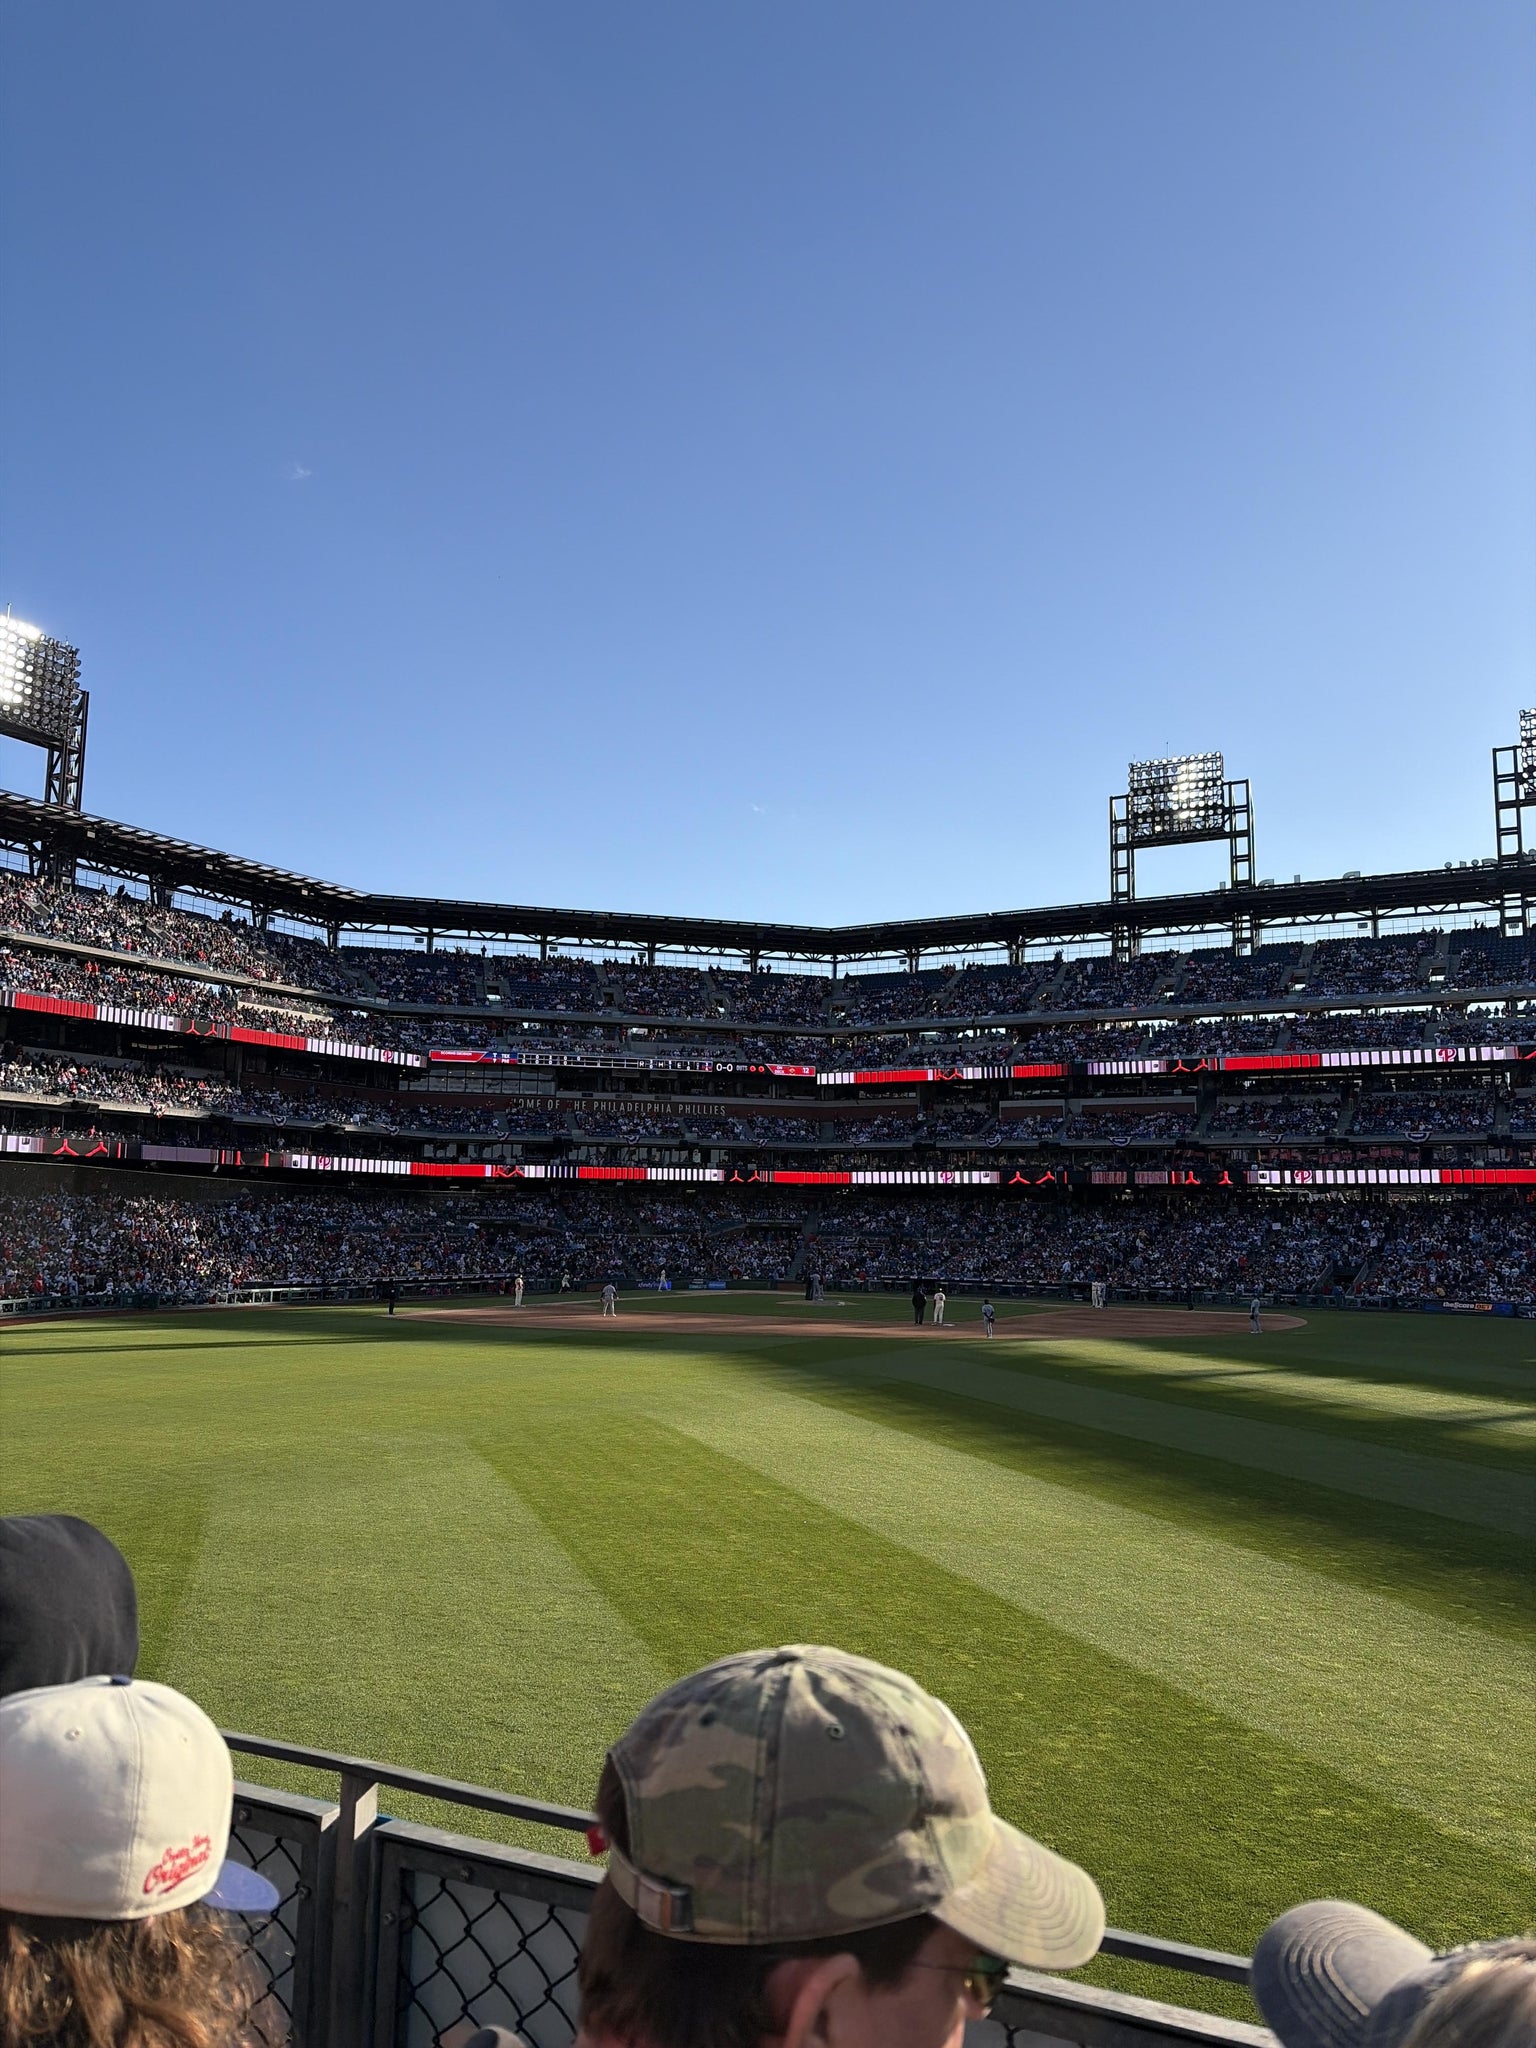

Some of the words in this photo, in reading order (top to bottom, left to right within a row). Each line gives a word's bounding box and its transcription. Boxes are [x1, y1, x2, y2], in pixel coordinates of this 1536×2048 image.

[716, 1063, 733, 1072] 0-0
[548, 1100, 560, 1110] OF
[594, 1101, 672, 1113] PHILADELPHIA
[678, 1104, 726, 1116] PHILLIES
